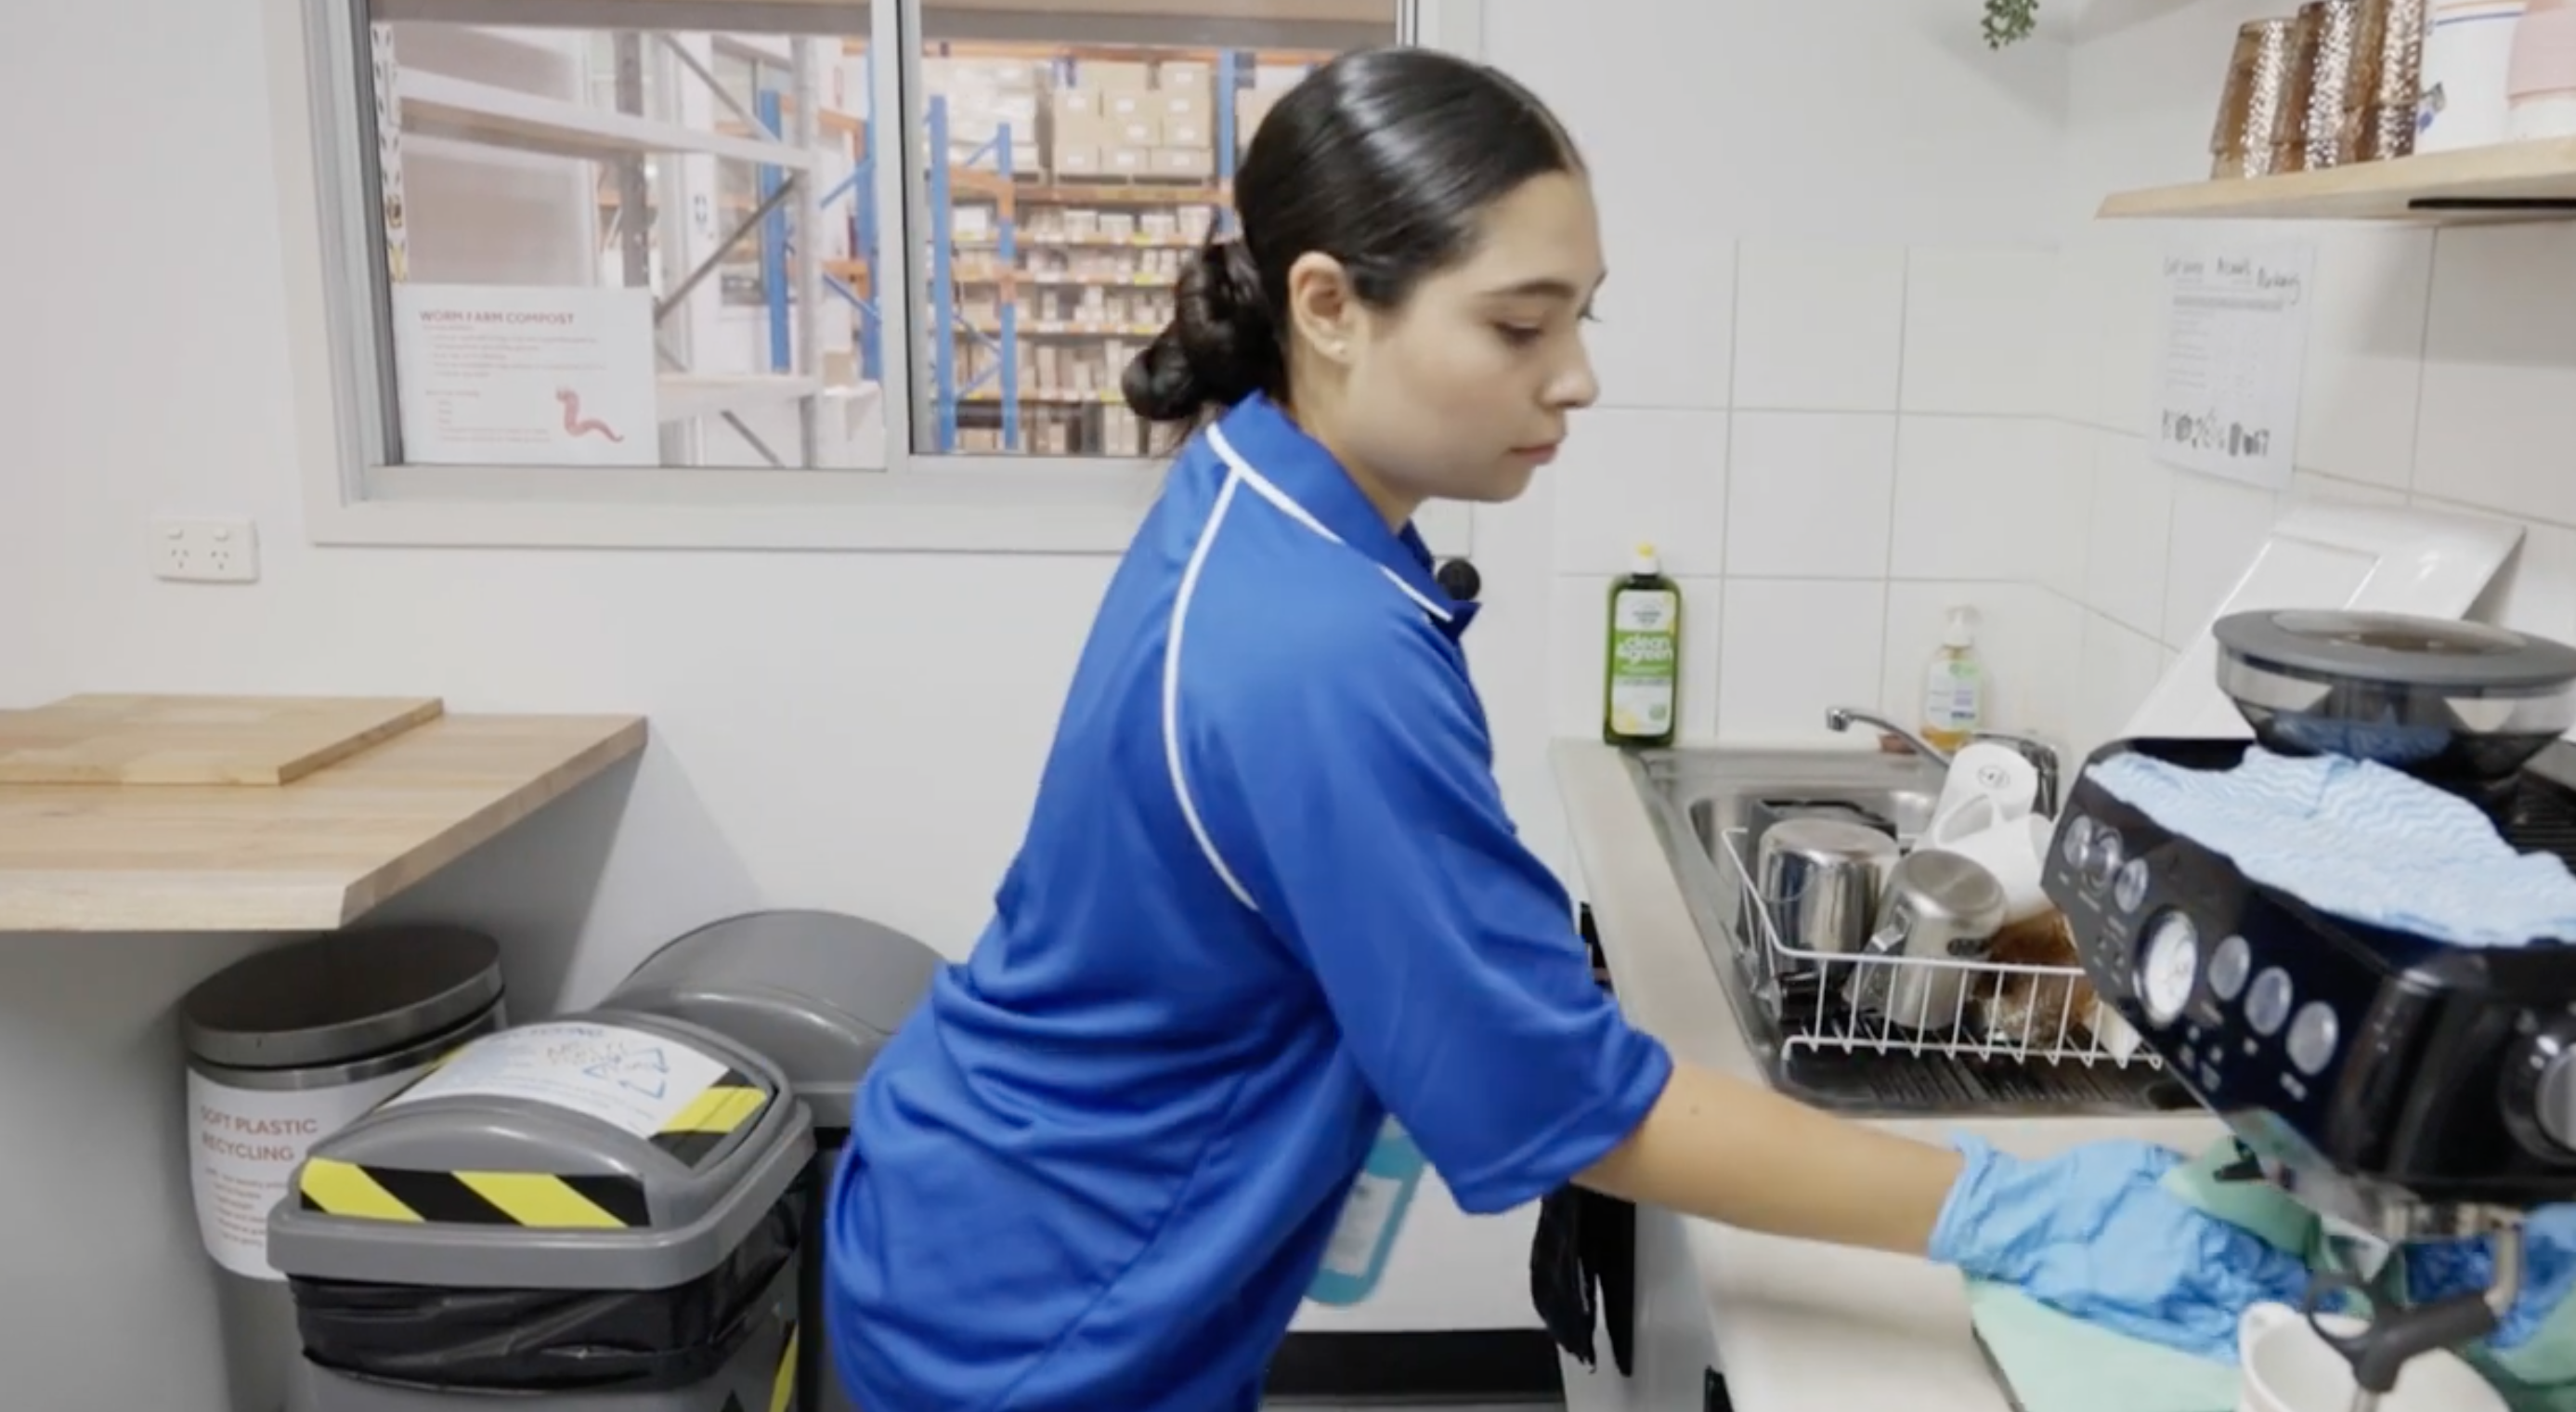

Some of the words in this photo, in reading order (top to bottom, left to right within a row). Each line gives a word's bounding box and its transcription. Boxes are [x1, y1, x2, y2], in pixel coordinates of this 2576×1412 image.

[419, 309, 463, 322] WORM
[466, 310, 503, 323] FARM
[505, 311, 575, 324] COMPOST
[200, 1105, 231, 1130] SOFT
[234, 1117, 319, 1135] PLASTIC
[202, 1131, 296, 1161] RECYCLING
